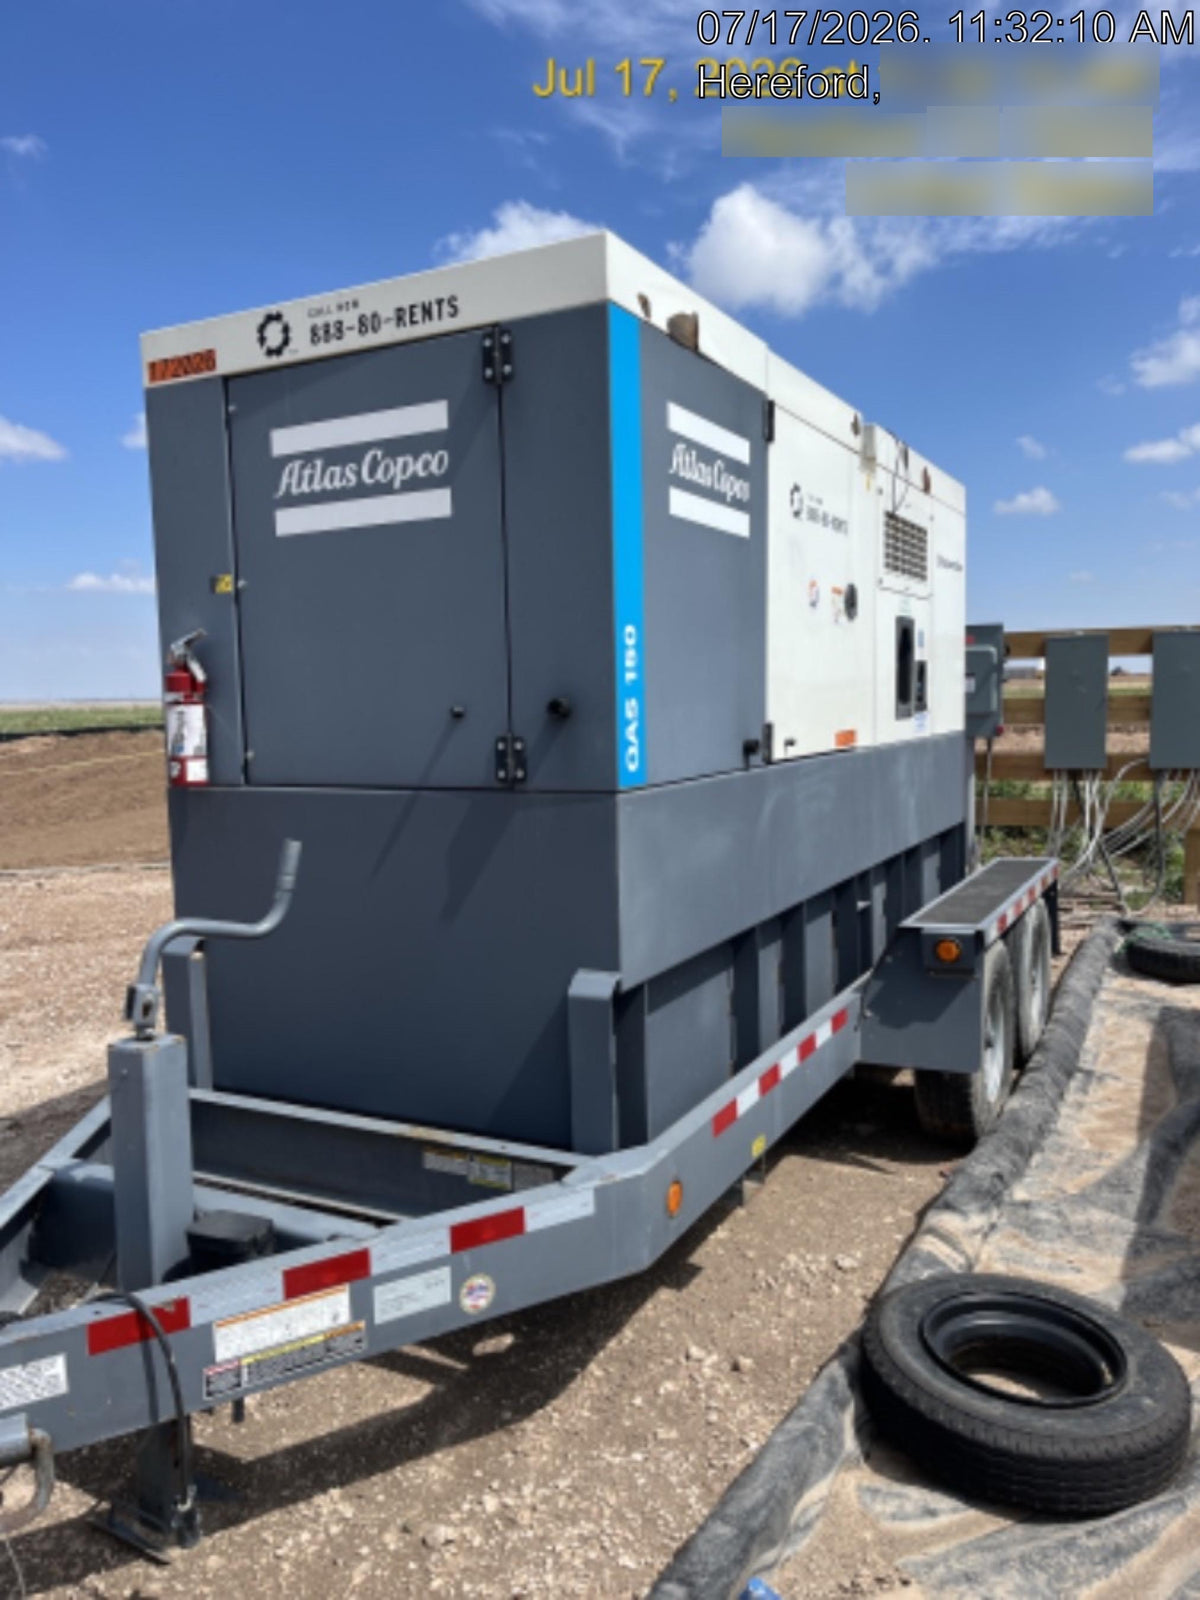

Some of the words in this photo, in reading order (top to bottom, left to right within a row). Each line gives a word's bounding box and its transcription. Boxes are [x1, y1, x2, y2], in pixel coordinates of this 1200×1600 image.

[309, 295, 460, 347] 888-80-RENTS
[274, 457, 360, 499] Atlas
[360, 447, 450, 491] Copco
[668, 443, 713, 489] Atlas
[624, 698, 640, 773] QAS
